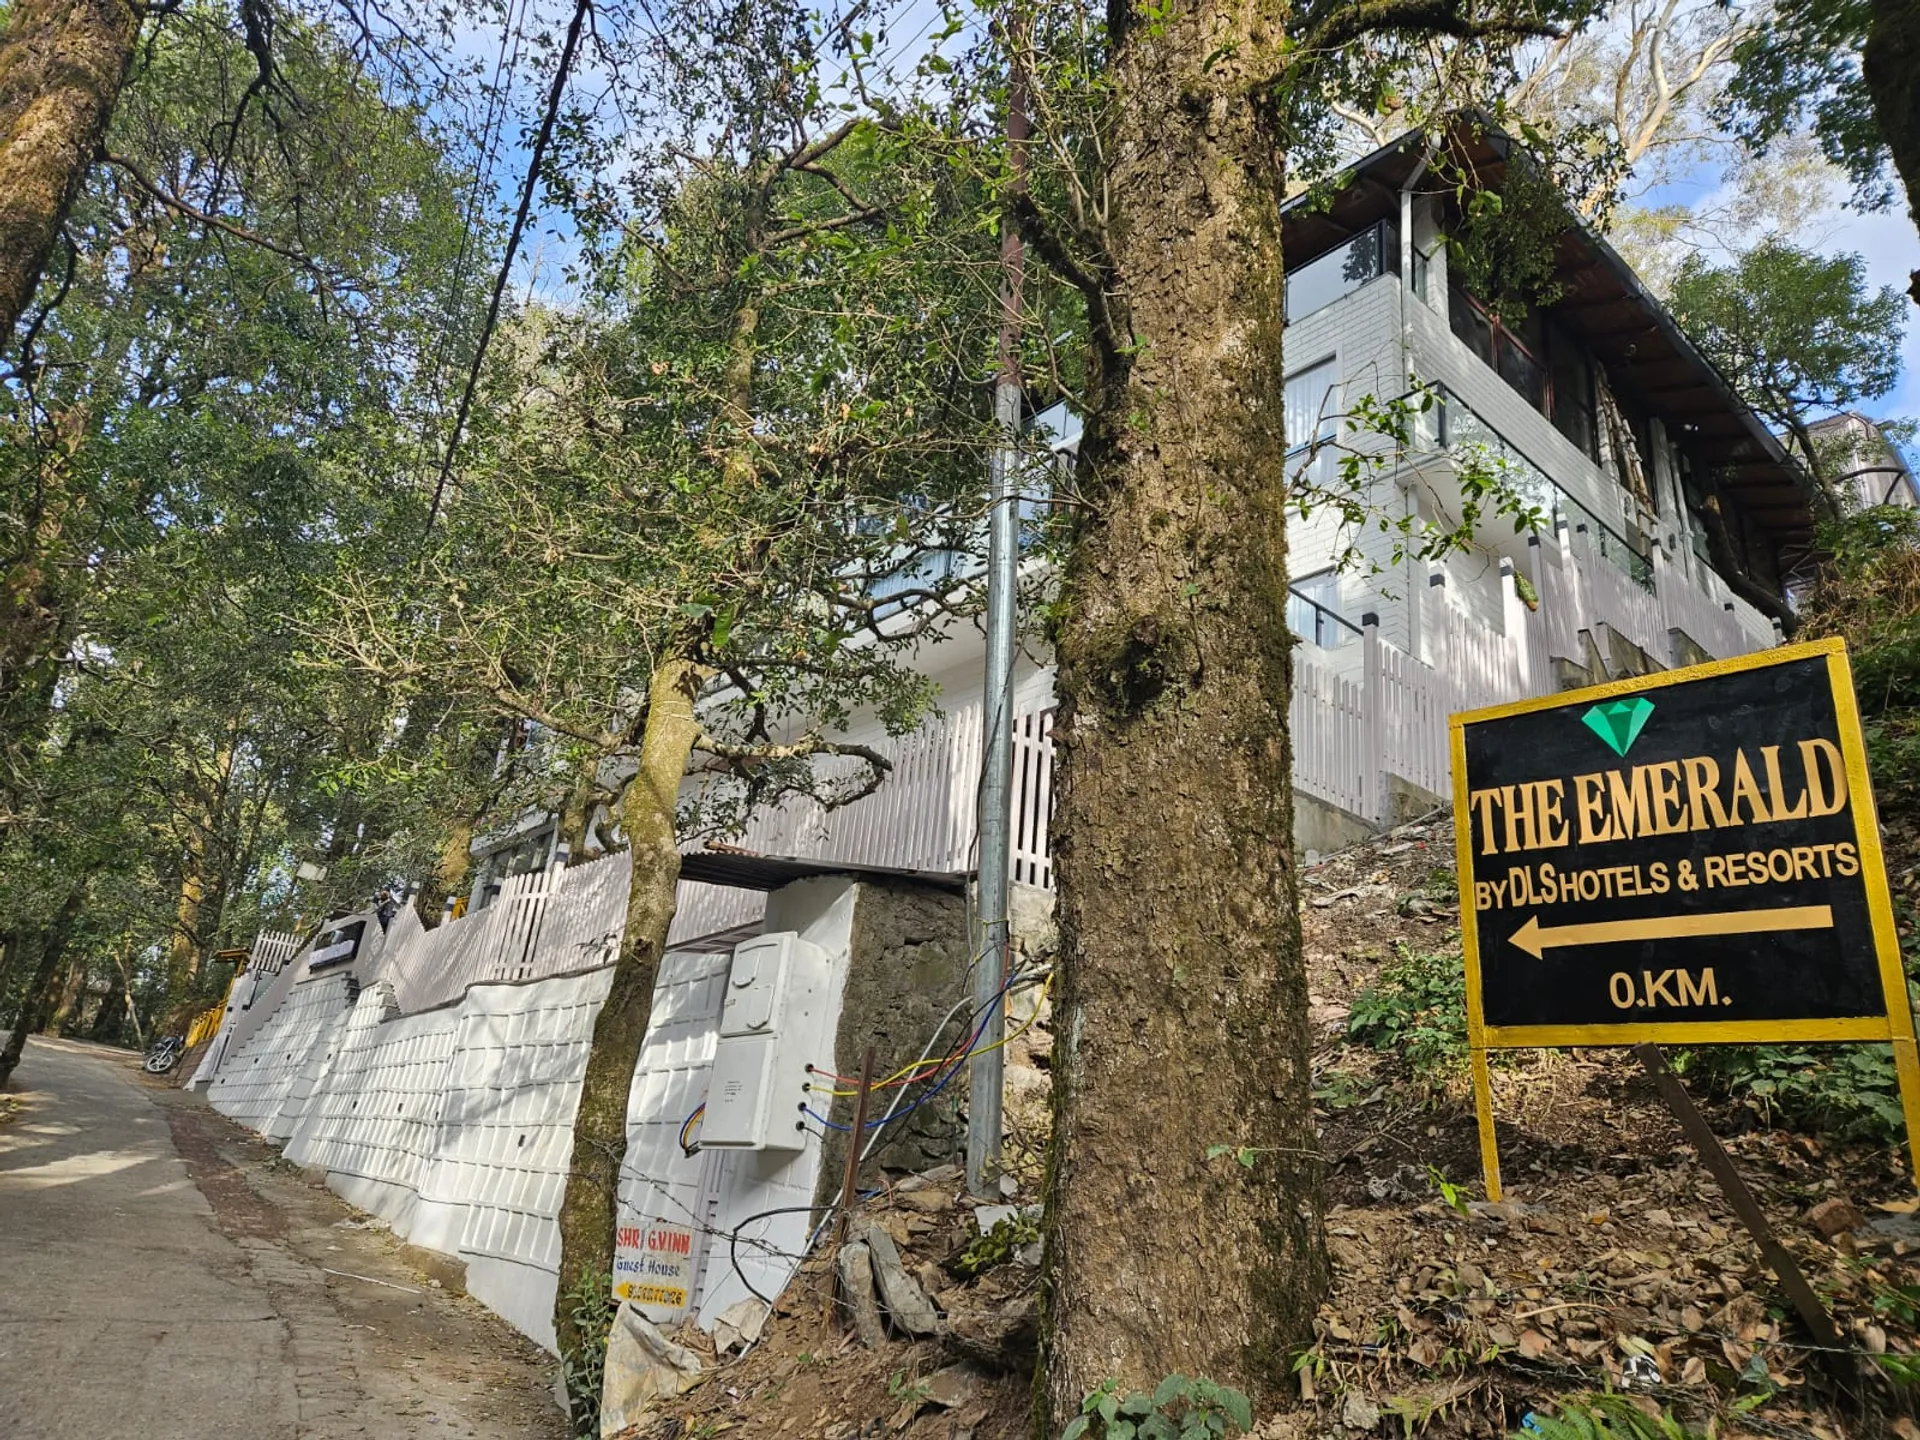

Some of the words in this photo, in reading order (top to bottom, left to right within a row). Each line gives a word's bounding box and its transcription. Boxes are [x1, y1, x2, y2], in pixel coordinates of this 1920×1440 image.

[1470, 778, 1569, 856] THE
[1572, 737, 1849, 845] EMERALD
[1474, 879, 1508, 911] BY
[1508, 862, 1558, 907] DLS
[1558, 861, 1671, 903] HOTELS
[1677, 859, 1700, 891] &
[1703, 842, 1860, 889] RESORTS
[616, 1258, 645, 1273] Guest
[647, 1260, 681, 1277] House
